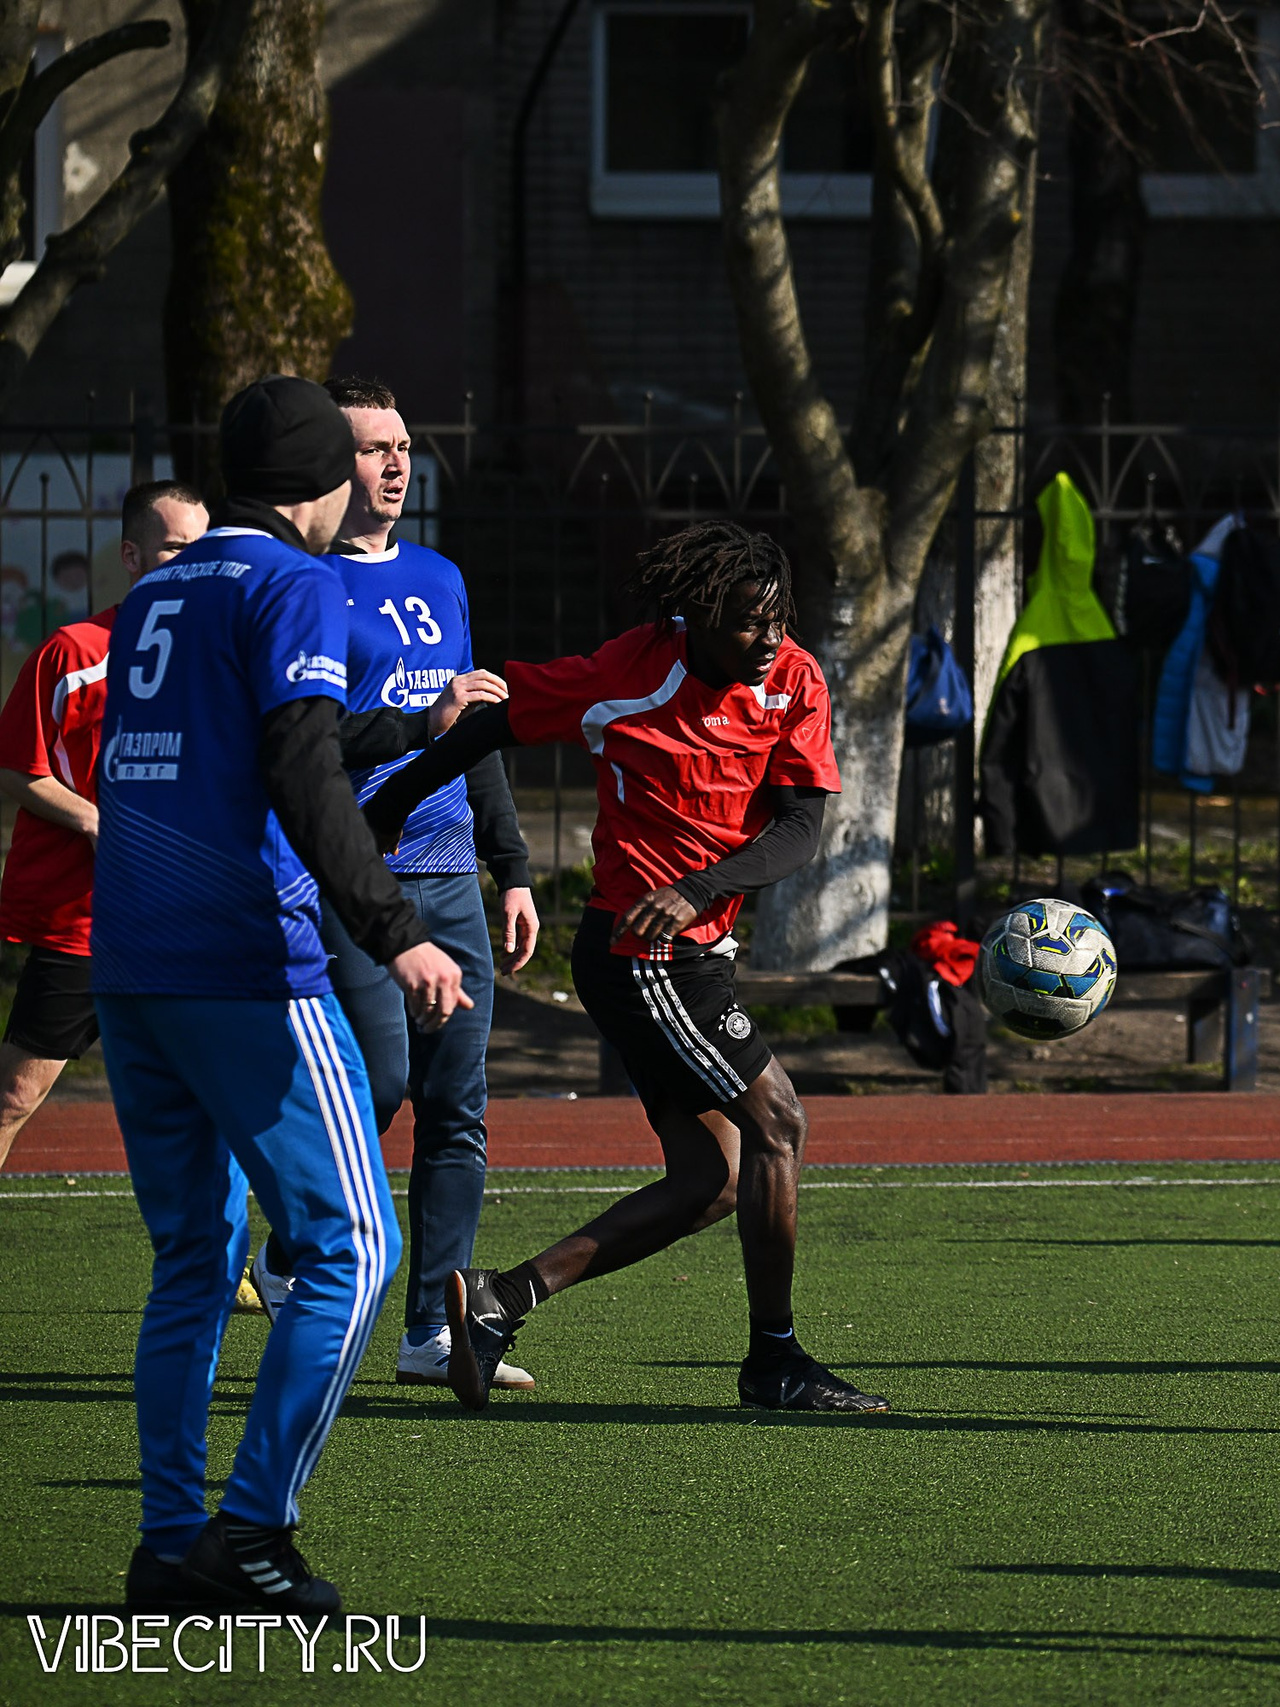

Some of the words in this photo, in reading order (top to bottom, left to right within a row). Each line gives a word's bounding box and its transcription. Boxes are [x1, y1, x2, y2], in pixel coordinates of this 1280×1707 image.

[378, 596, 443, 646] 13
[128, 599, 185, 700] 5
[119, 732, 182, 757] ГАЗПРОМ
[124, 765, 166, 778] ПХГ
